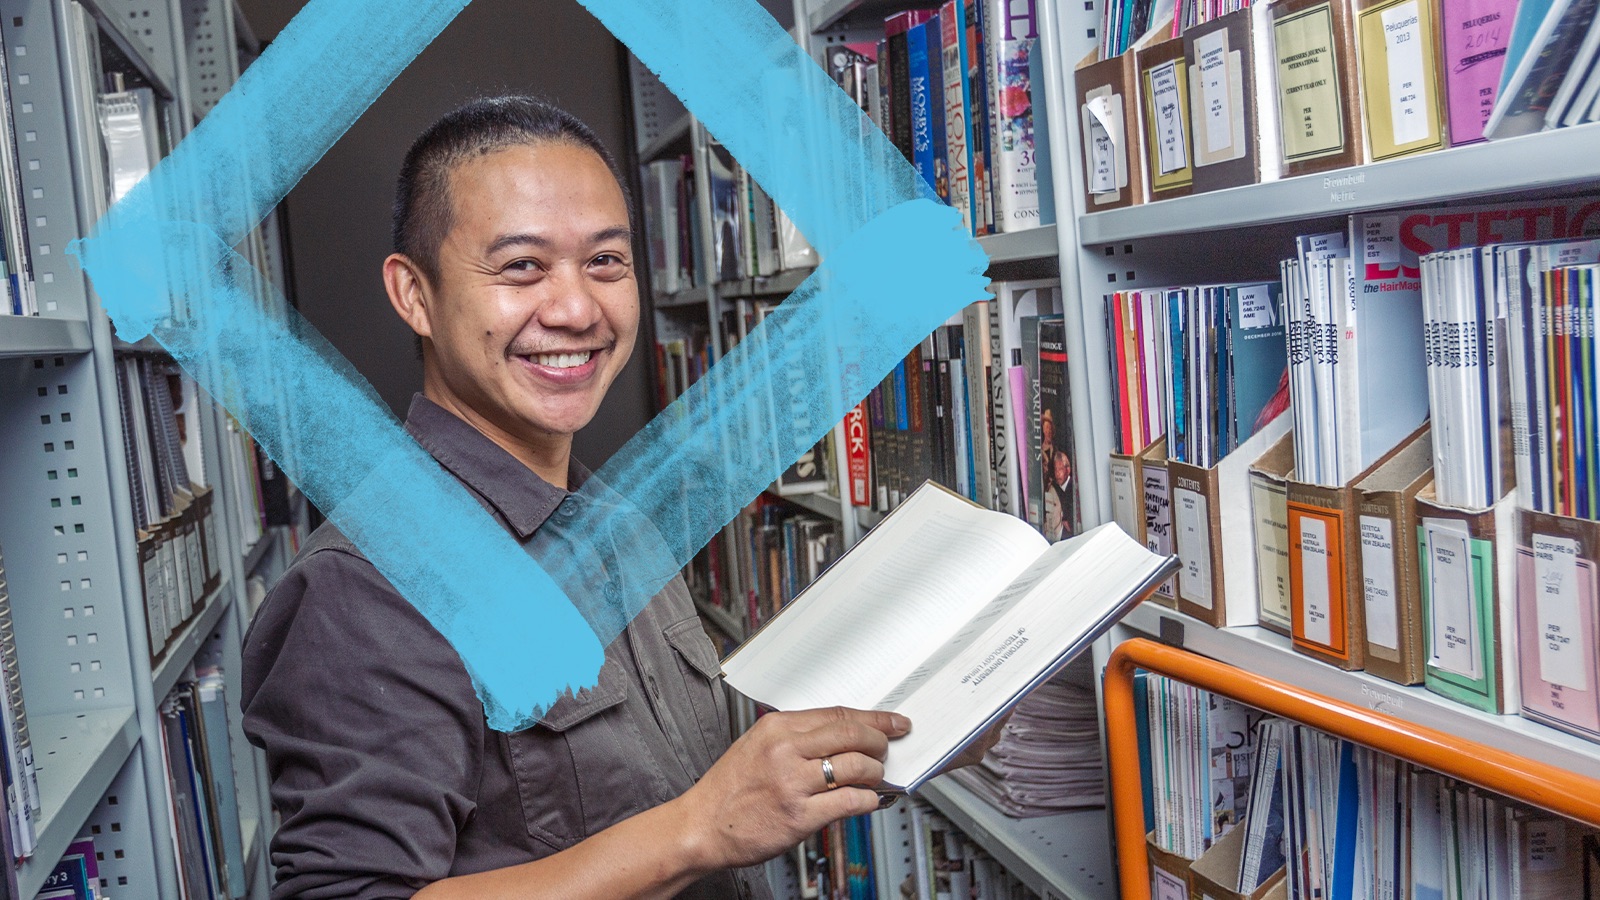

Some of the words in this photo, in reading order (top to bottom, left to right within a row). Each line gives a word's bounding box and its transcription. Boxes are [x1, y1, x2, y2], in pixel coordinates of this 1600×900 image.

[1396, 32, 1411, 44] 2013
[1281, 52, 1308, 65] HAIRDRESSERS
[1308, 46, 1327, 57] JOURNAL
[1288, 57, 1319, 70] INTERNATIONAL
[1286, 85, 1303, 95] CURRENT
[1304, 82, 1315, 90] YEAR
[1315, 79, 1327, 87] ONLY
[1480, 87, 1492, 97] PER
[950, 82, 968, 193] HOME
[1324, 172, 1365, 189] Brownbuilt
[1331, 191, 1356, 203] Metric
[1364, 284, 1379, 293] the
[1244, 332, 1270, 340] DECEMBER
[1290, 321, 1298, 366] ESTETICA
[1316, 324, 1324, 364] ESTETICA
[1470, 321, 1478, 367] ESTETICA
[1178, 476, 1200, 491] CONTENTS
[1360, 503, 1389, 514] CONTENTS
[1154, 523, 1170, 536] 2015
[1361, 524, 1380, 532] ESTETICA
[1362, 532, 1384, 540] AUSTRALIA
[1363, 539, 1372, 547] NEW
[1372, 541, 1391, 549] ZEALAND
[1535, 542, 1565, 553] COIFFURE
[1436, 547, 1455, 557] ESTETICA
[1536, 551, 1553, 561] PARIS
[1437, 556, 1451, 564] WORLD
[1546, 585, 1559, 595] 2015
[1017, 627, 1026, 636] OF
[1447, 625, 1455, 633] PER
[1548, 624, 1560, 633] PER
[982, 634, 1019, 666] TECHNOLOGY
[1001, 637, 1029, 660] VICTORIA
[972, 658, 1005, 686] UNIVERSITY
[44, 875, 58, 885] ry
[60, 872, 68, 881] 3
